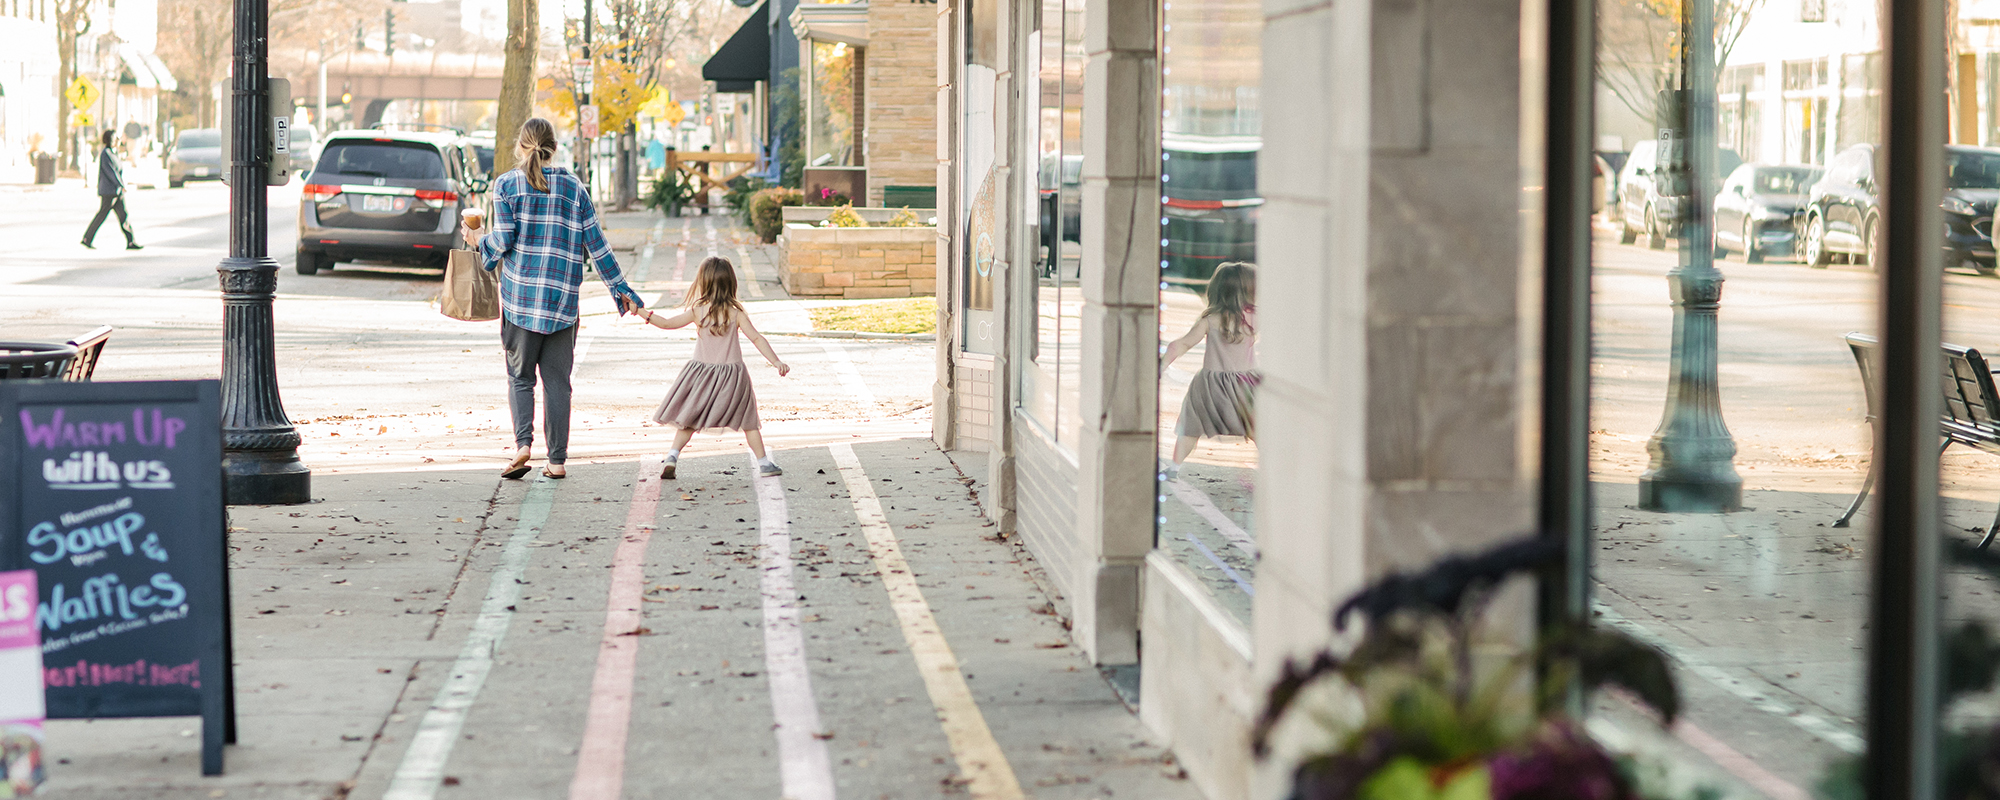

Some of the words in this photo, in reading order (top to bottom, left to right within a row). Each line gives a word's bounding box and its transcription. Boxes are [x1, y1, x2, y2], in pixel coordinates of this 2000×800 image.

[277, 120, 287, 150] loop
[42, 450, 121, 482] with
[123, 459, 172, 482] us
[27, 512, 145, 564] Soup
